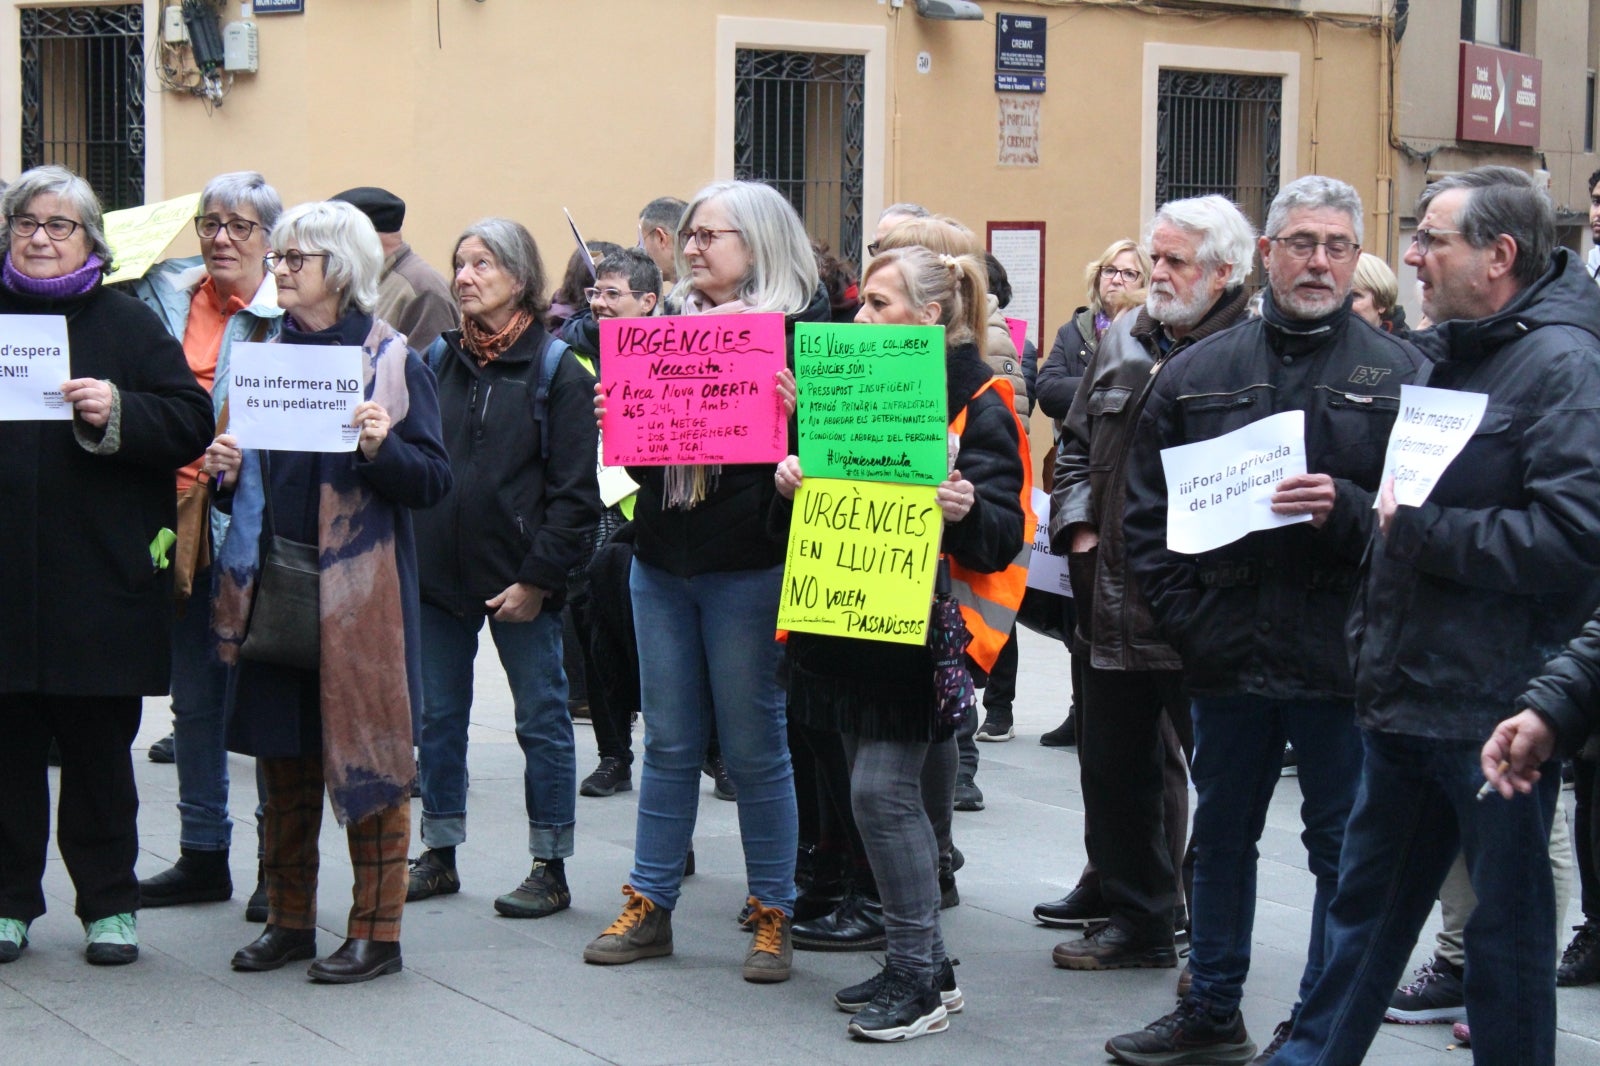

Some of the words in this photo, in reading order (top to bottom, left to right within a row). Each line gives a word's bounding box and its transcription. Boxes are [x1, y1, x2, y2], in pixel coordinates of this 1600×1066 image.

[1012, 39, 1033, 49] CREMAT
[800, 334, 821, 354] ELS
[859, 341, 877, 353] QUE
[235, 375, 260, 388] Una
[264, 376, 332, 390] infermera
[336, 379, 359, 391] NO
[662, 384, 694, 400] Nova
[701, 380, 759, 398] OBERTA
[807, 382, 853, 396] PRESSUPOST
[246, 396, 260, 407] és
[263, 399, 279, 408] un
[283, 398, 347, 411] pediatre!!!
[622, 404, 645, 419] 365
[823, 415, 854, 425] ABORDAR
[1403, 406, 1425, 425] Més
[1424, 413, 1465, 432] metges
[670, 425, 748, 441] INFERMERES
[850, 432, 883, 442] LABORALS
[887, 433, 903, 442] DEL
[649, 442, 669, 453] UNA
[1226, 465, 1237, 478] la
[1240, 445, 1291, 475] privada
[1190, 498, 1207, 511] de
[1211, 493, 1222, 505] la
[1226, 468, 1284, 499] Pública!!!
[800, 539, 823, 560] EN
[790, 574, 819, 609] NO
[826, 587, 867, 610] VOLEM
